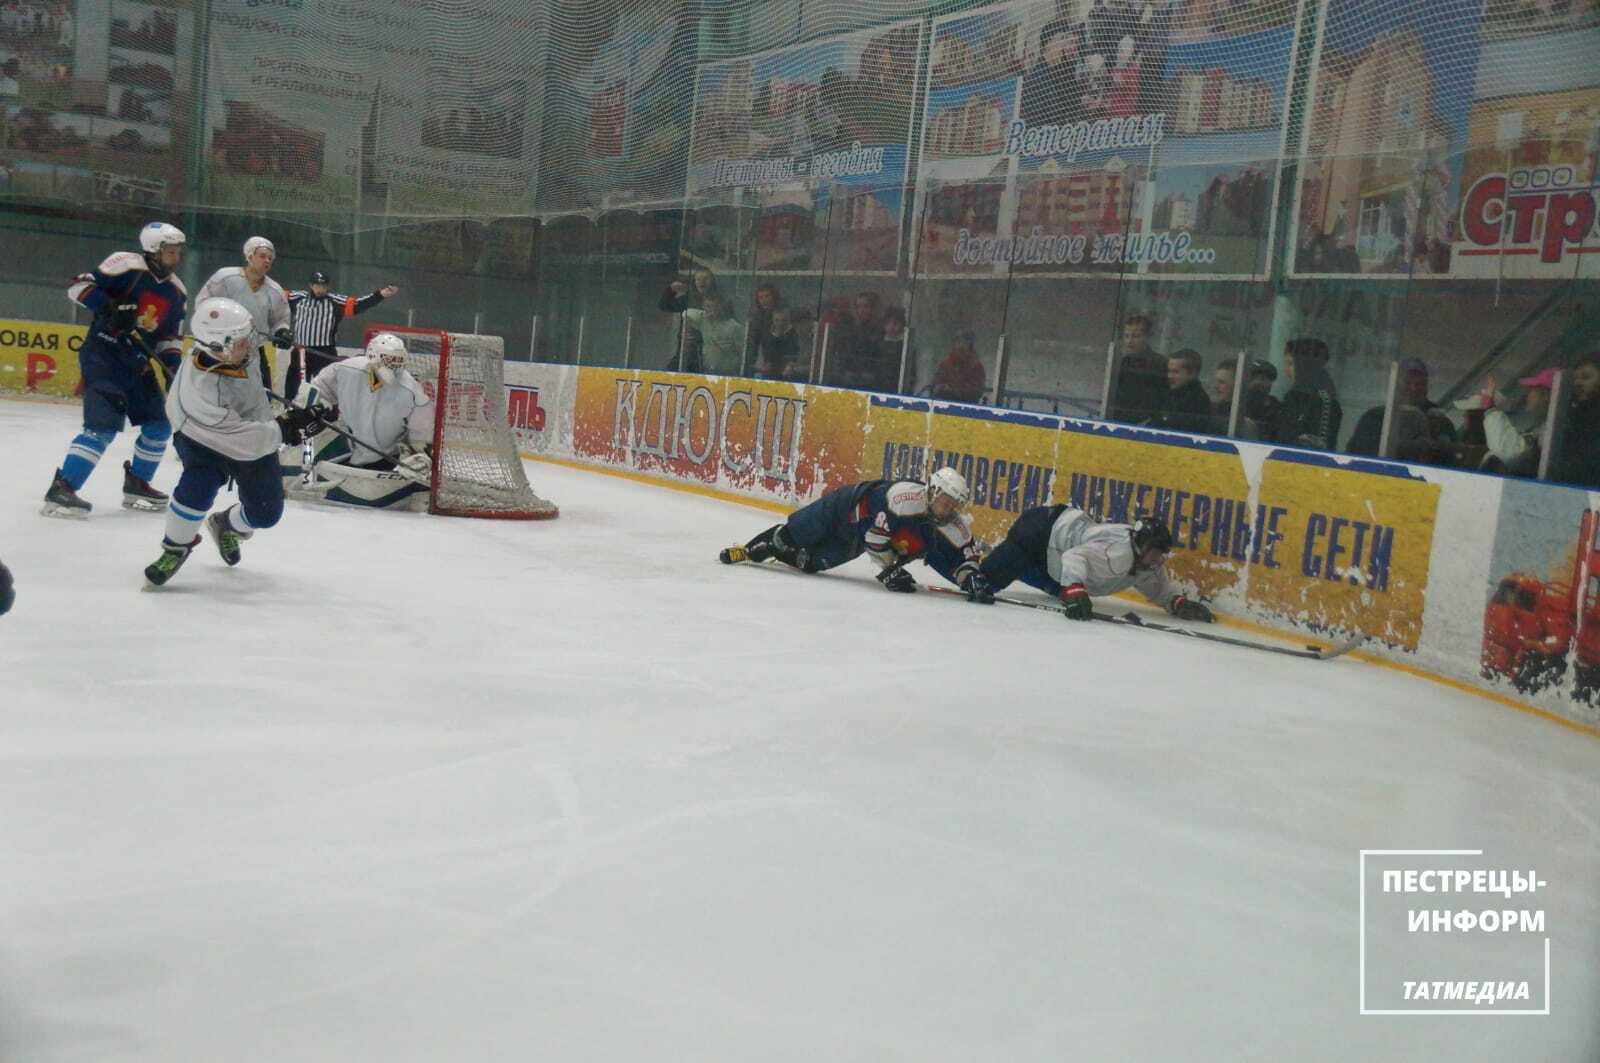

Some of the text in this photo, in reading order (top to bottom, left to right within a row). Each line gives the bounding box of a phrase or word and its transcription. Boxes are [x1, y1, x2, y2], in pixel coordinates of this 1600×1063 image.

[1004, 113, 1165, 162] Ветеранам
[953, 224, 1087, 265] достойное
[1302, 513, 1395, 592] СЕТИ
